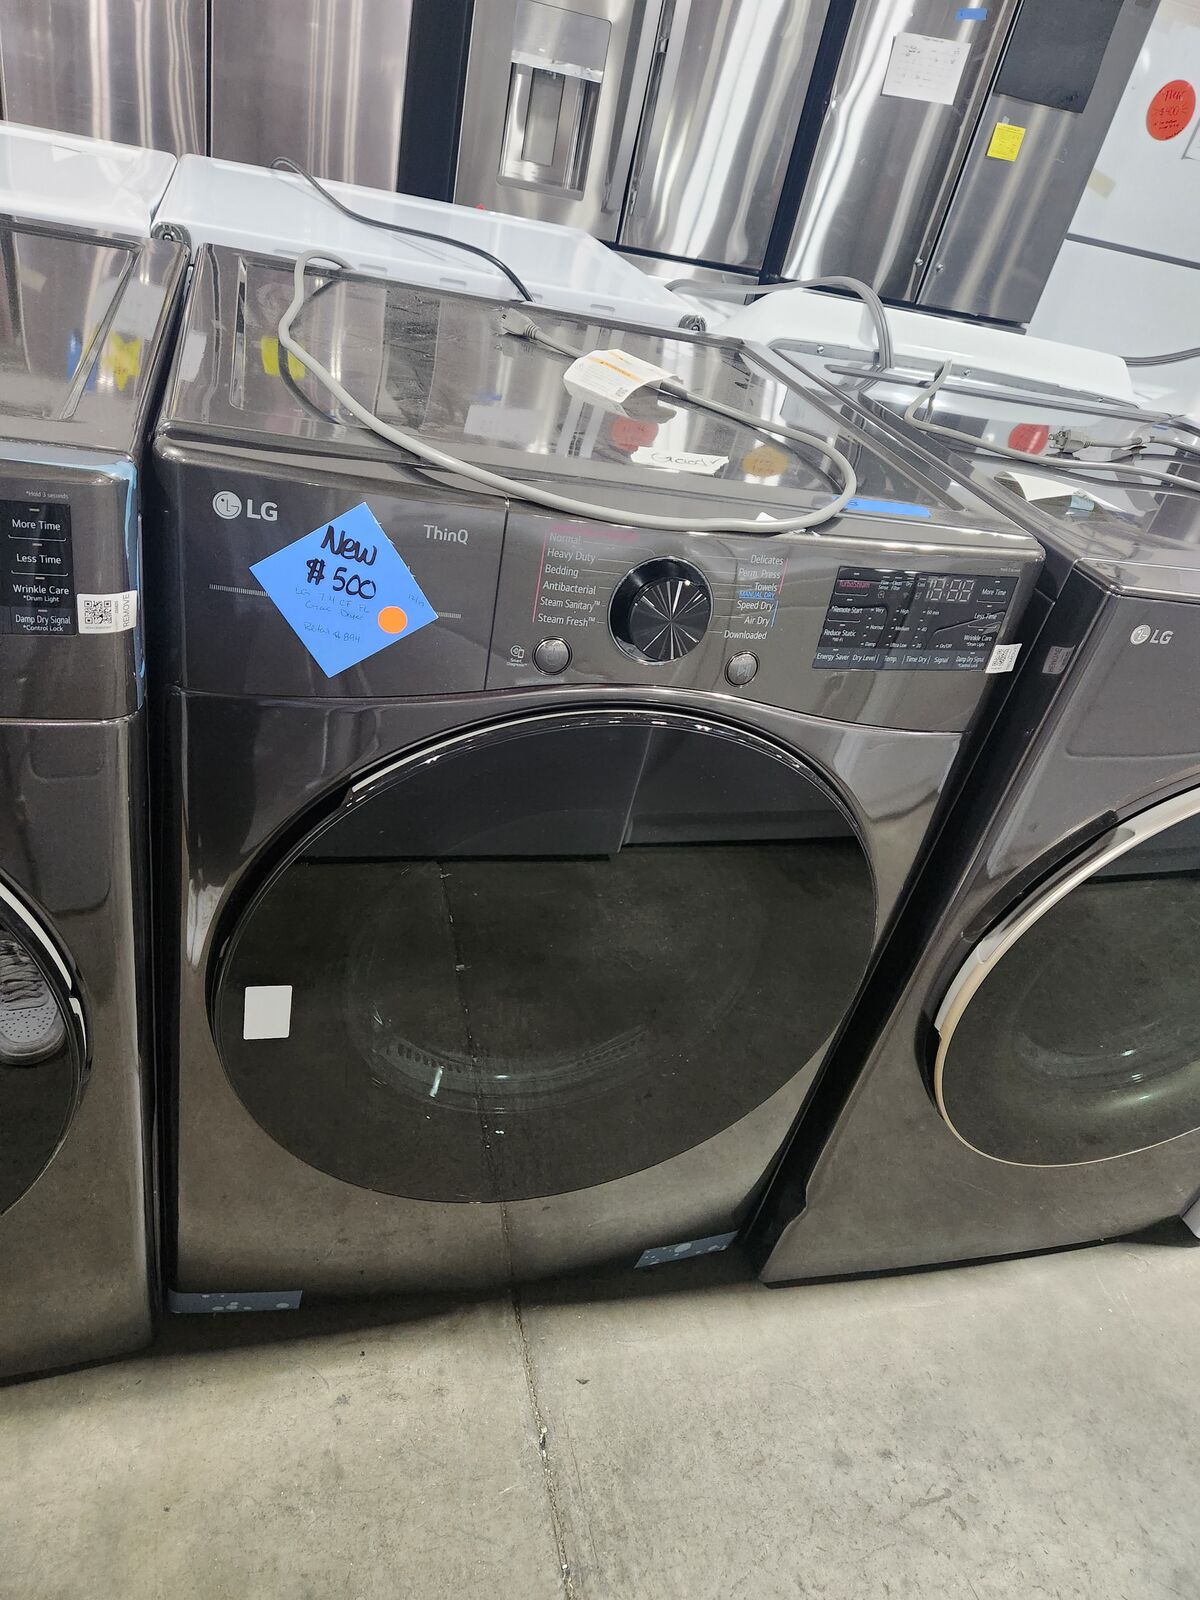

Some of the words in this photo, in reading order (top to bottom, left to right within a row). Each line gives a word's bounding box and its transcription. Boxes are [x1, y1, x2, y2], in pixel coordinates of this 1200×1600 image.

[247, 499, 278, 522] LG
[12, 519, 37, 529] More
[38, 520, 61, 531] Time
[423, 524, 469, 545] ThinQ
[549, 532, 581, 544] Normal
[321, 525, 377, 566] New
[16, 553, 37, 564] Less
[39, 554, 62, 565] Time
[547, 547, 575, 562] Heavy
[575, 551, 597, 566] Duty
[750, 554, 784, 566] Delicates
[545, 563, 579, 579] Bedding
[761, 569, 781, 579] Press
[12, 584, 48, 595] Wrinkle
[48, 585, 70, 596] Care
[542, 580, 597, 595] Antibacterial
[754, 582, 778, 592] Towels
[981, 588, 996, 596] More
[995, 589, 1007, 597] Time
[44, 595, 60, 603] Light
[540, 596, 564, 608] Steam
[122, 593, 131, 628] REMOVE
[736, 600, 760, 611] Speed
[760, 601, 774, 612] Dry
[850, 606, 863, 614] Start
[15, 614, 36, 624] Damp
[37, 615, 49, 625] Dry
[50, 616, 71, 626] Signal
[537, 613, 564, 625] Steam
[744, 616, 756, 625] Air
[756, 616, 770, 628] Dry
[723, 630, 768, 640] Downloaded
[823, 628, 841, 637] Reduce
[841, 629, 857, 638] Static
[1149, 629, 1174, 645] LG
[816, 652, 835, 662] Energy
[834, 653, 850, 661] Saver
[852, 653, 862, 663] Dry
[862, 654, 877, 662] Level
